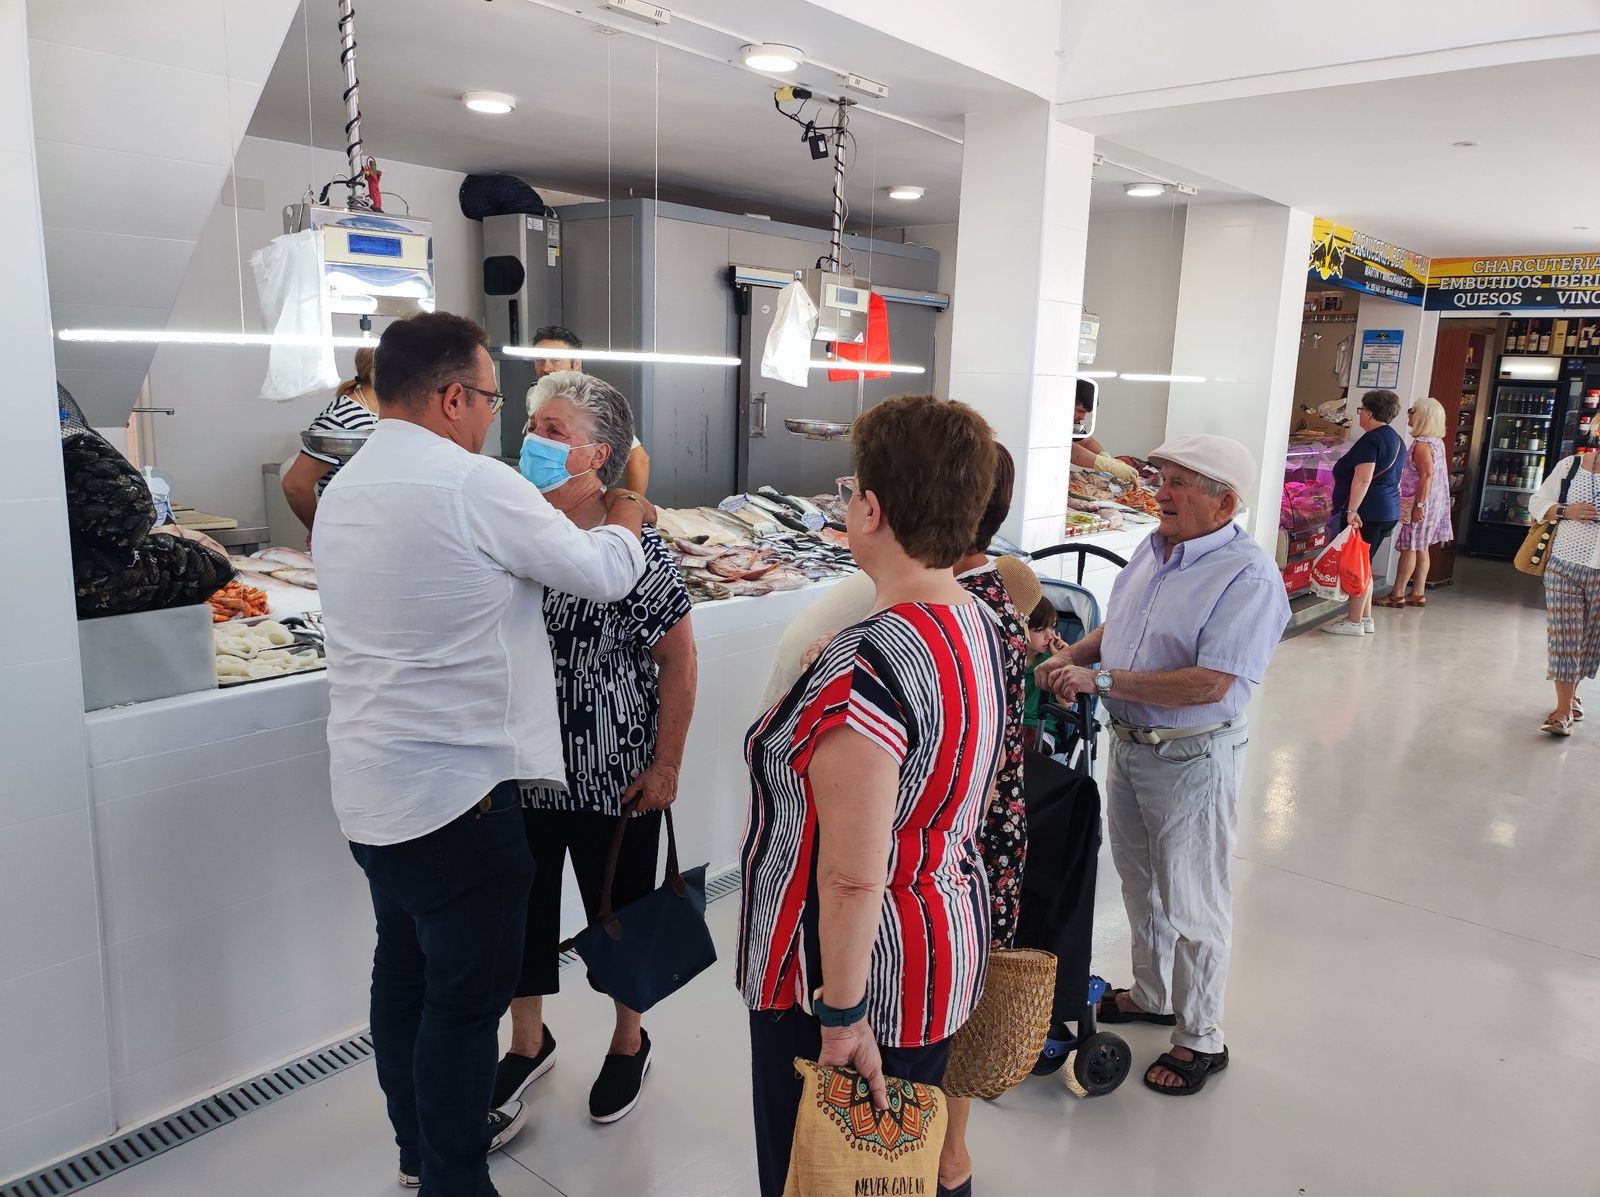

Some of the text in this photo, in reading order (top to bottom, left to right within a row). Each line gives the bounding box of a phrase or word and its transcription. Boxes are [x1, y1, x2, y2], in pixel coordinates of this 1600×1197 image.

[1472, 256, 1600, 274] CHARCUTERIA
[1439, 269, 1600, 291] EMBUTIDOS IBÉRI
[1453, 291, 1522, 308] QUESOS
[854, 1176, 889, 1197] NEVER
[892, 1176, 914, 1196] GIVE
